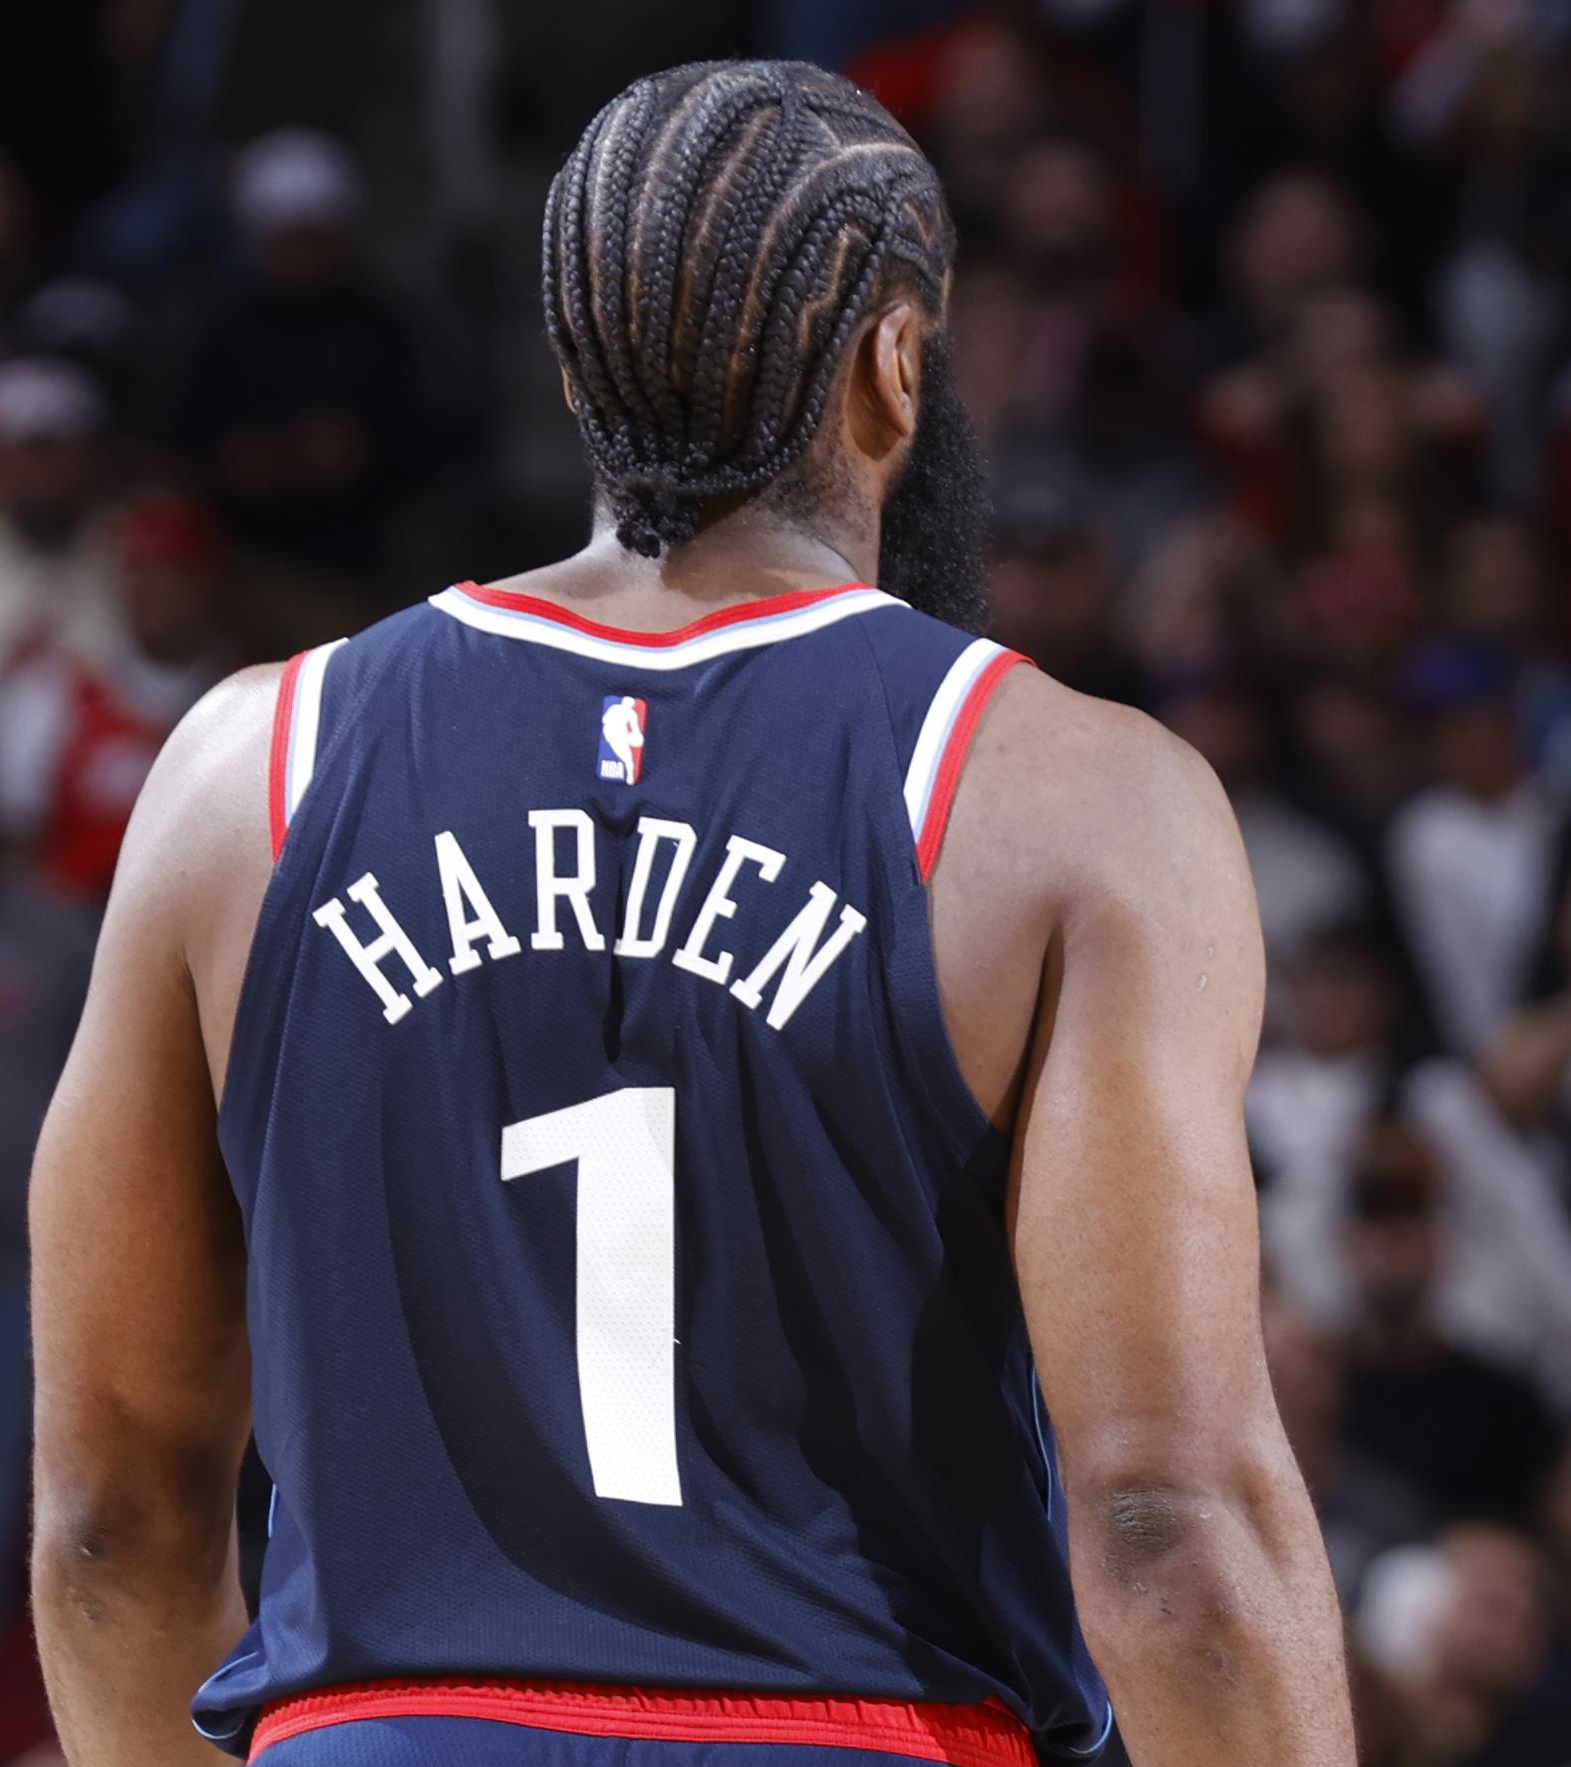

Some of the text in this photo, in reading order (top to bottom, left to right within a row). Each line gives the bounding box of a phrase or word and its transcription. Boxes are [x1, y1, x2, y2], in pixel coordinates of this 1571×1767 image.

[600, 760, 625, 779] NBA
[312, 808, 868, 1031] HARDEN
[500, 1086, 683, 1507] 1
